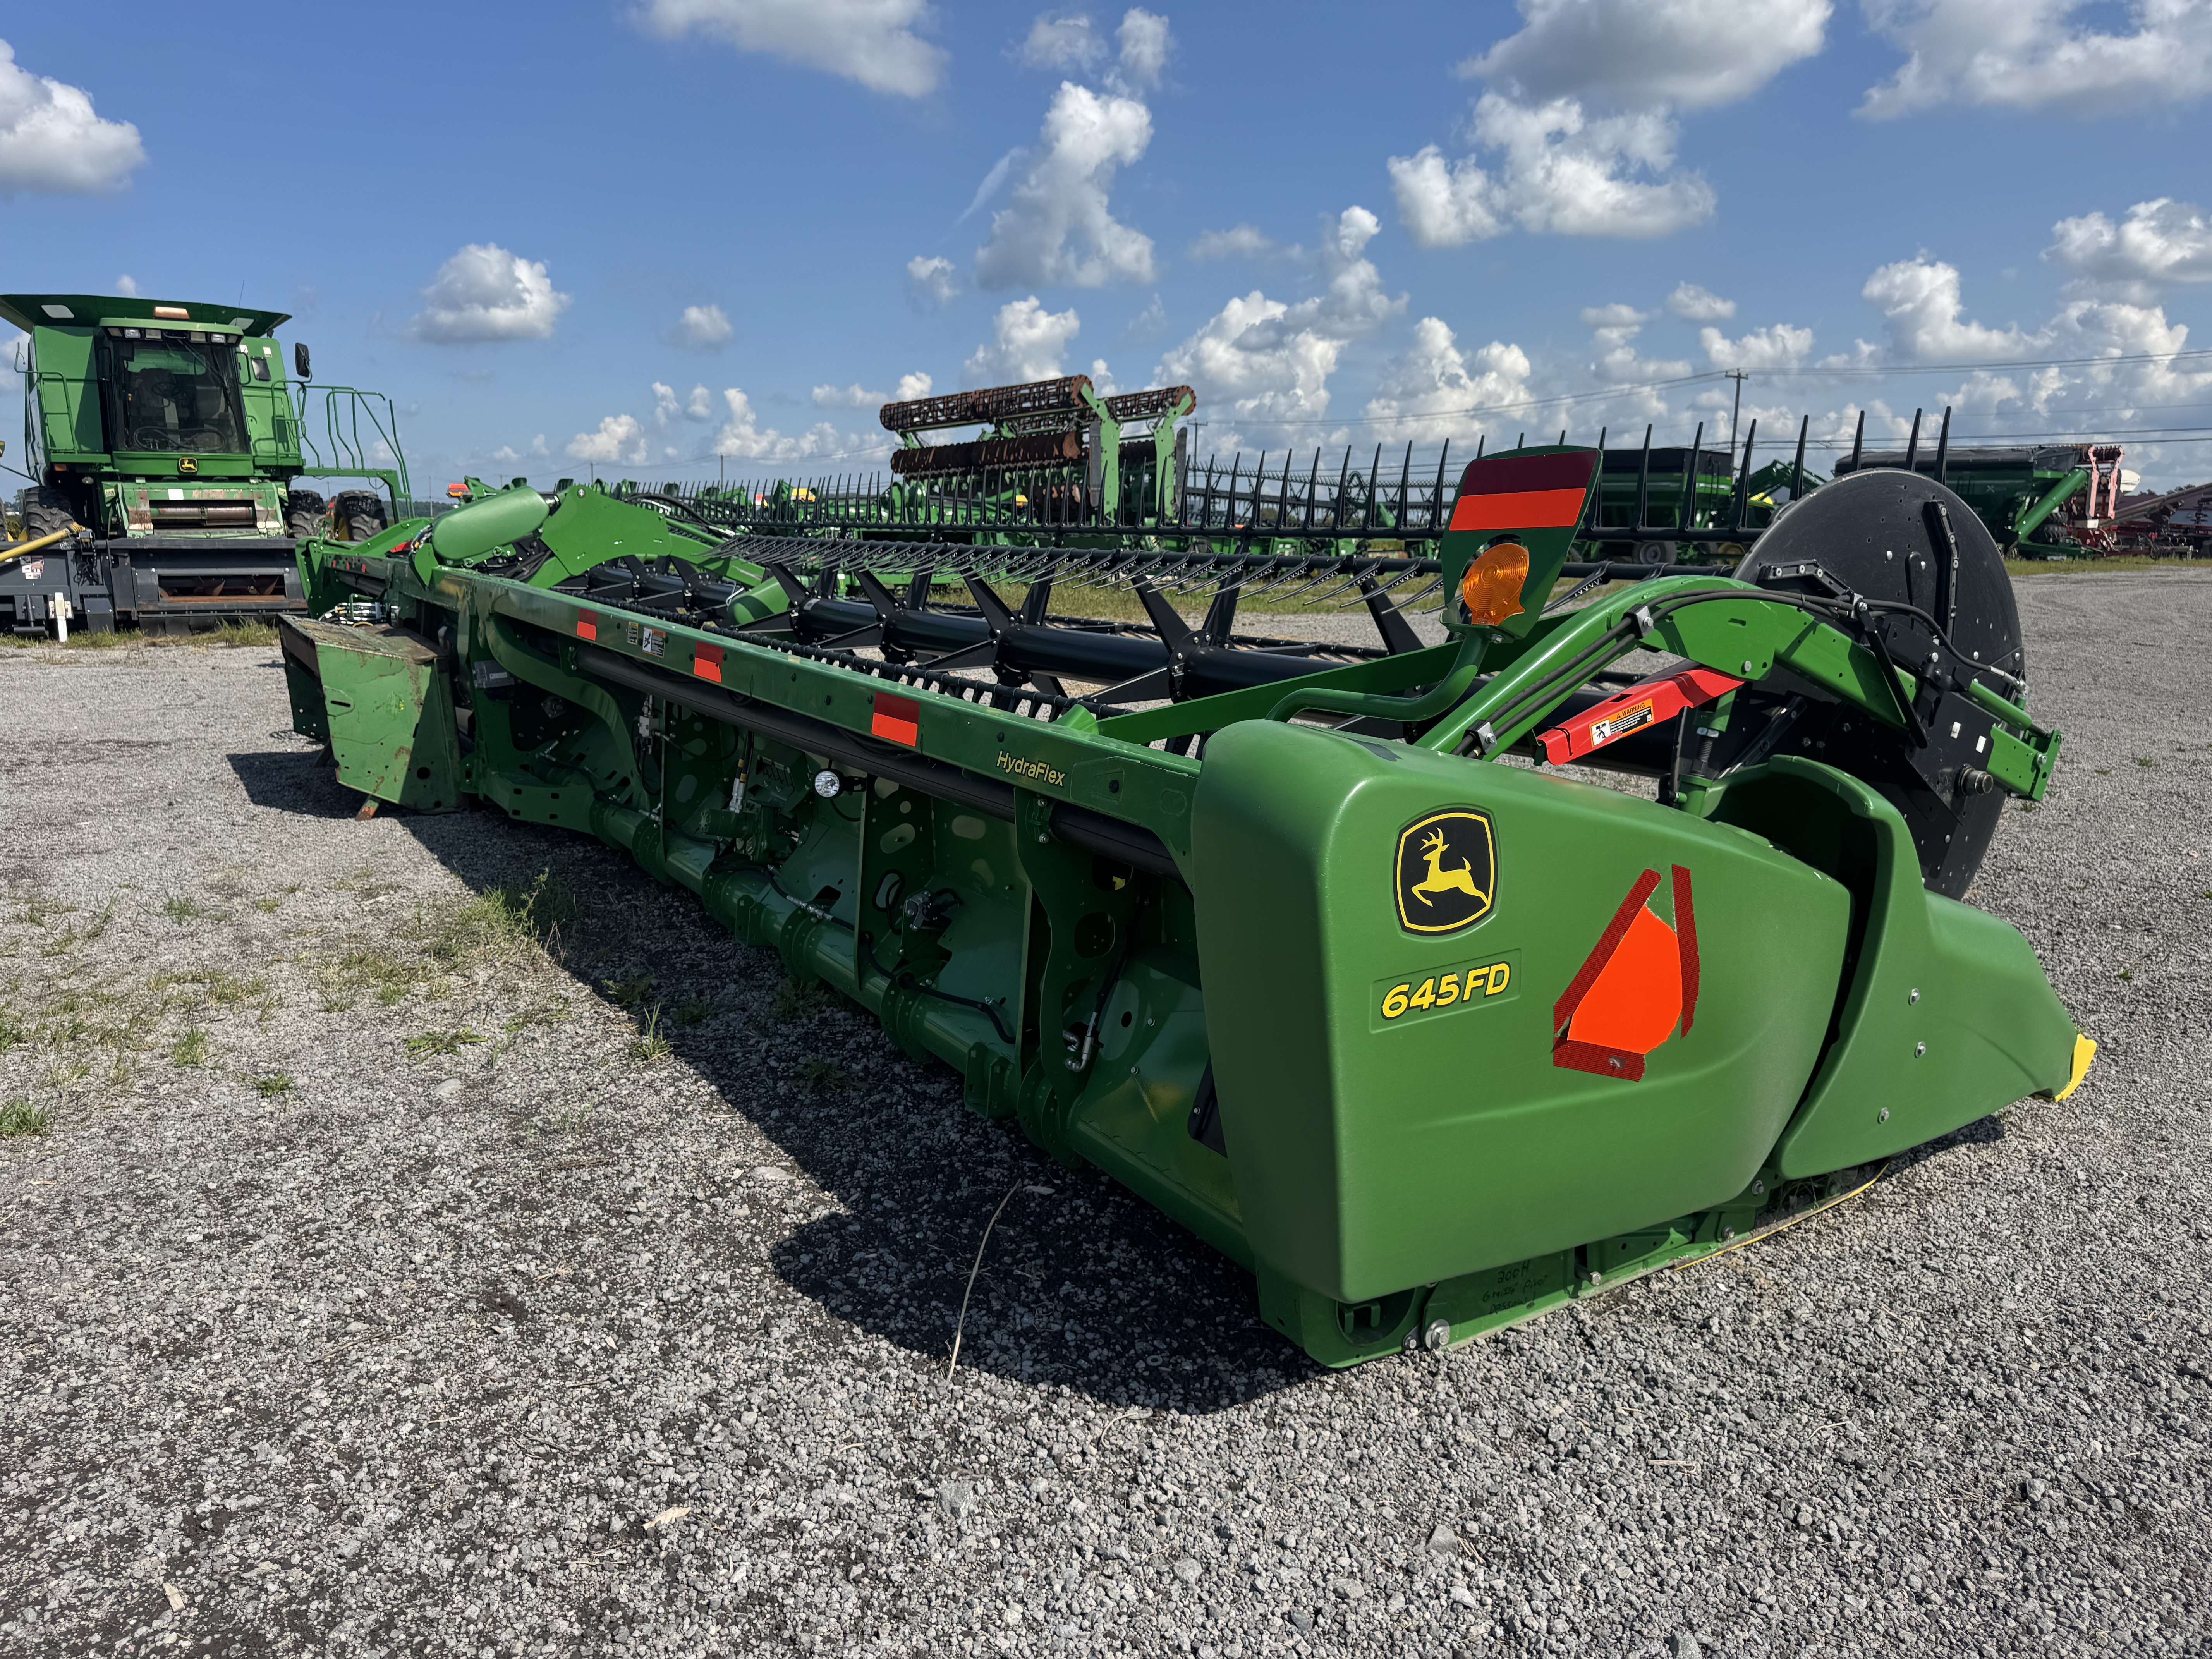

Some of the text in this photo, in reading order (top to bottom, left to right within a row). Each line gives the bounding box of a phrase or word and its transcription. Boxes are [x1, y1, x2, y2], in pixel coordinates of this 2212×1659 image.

[1622, 702, 1645, 716] WARNING
[996, 750, 1066, 786] HydraFlex
[1381, 961, 1510, 1020] 645FD
